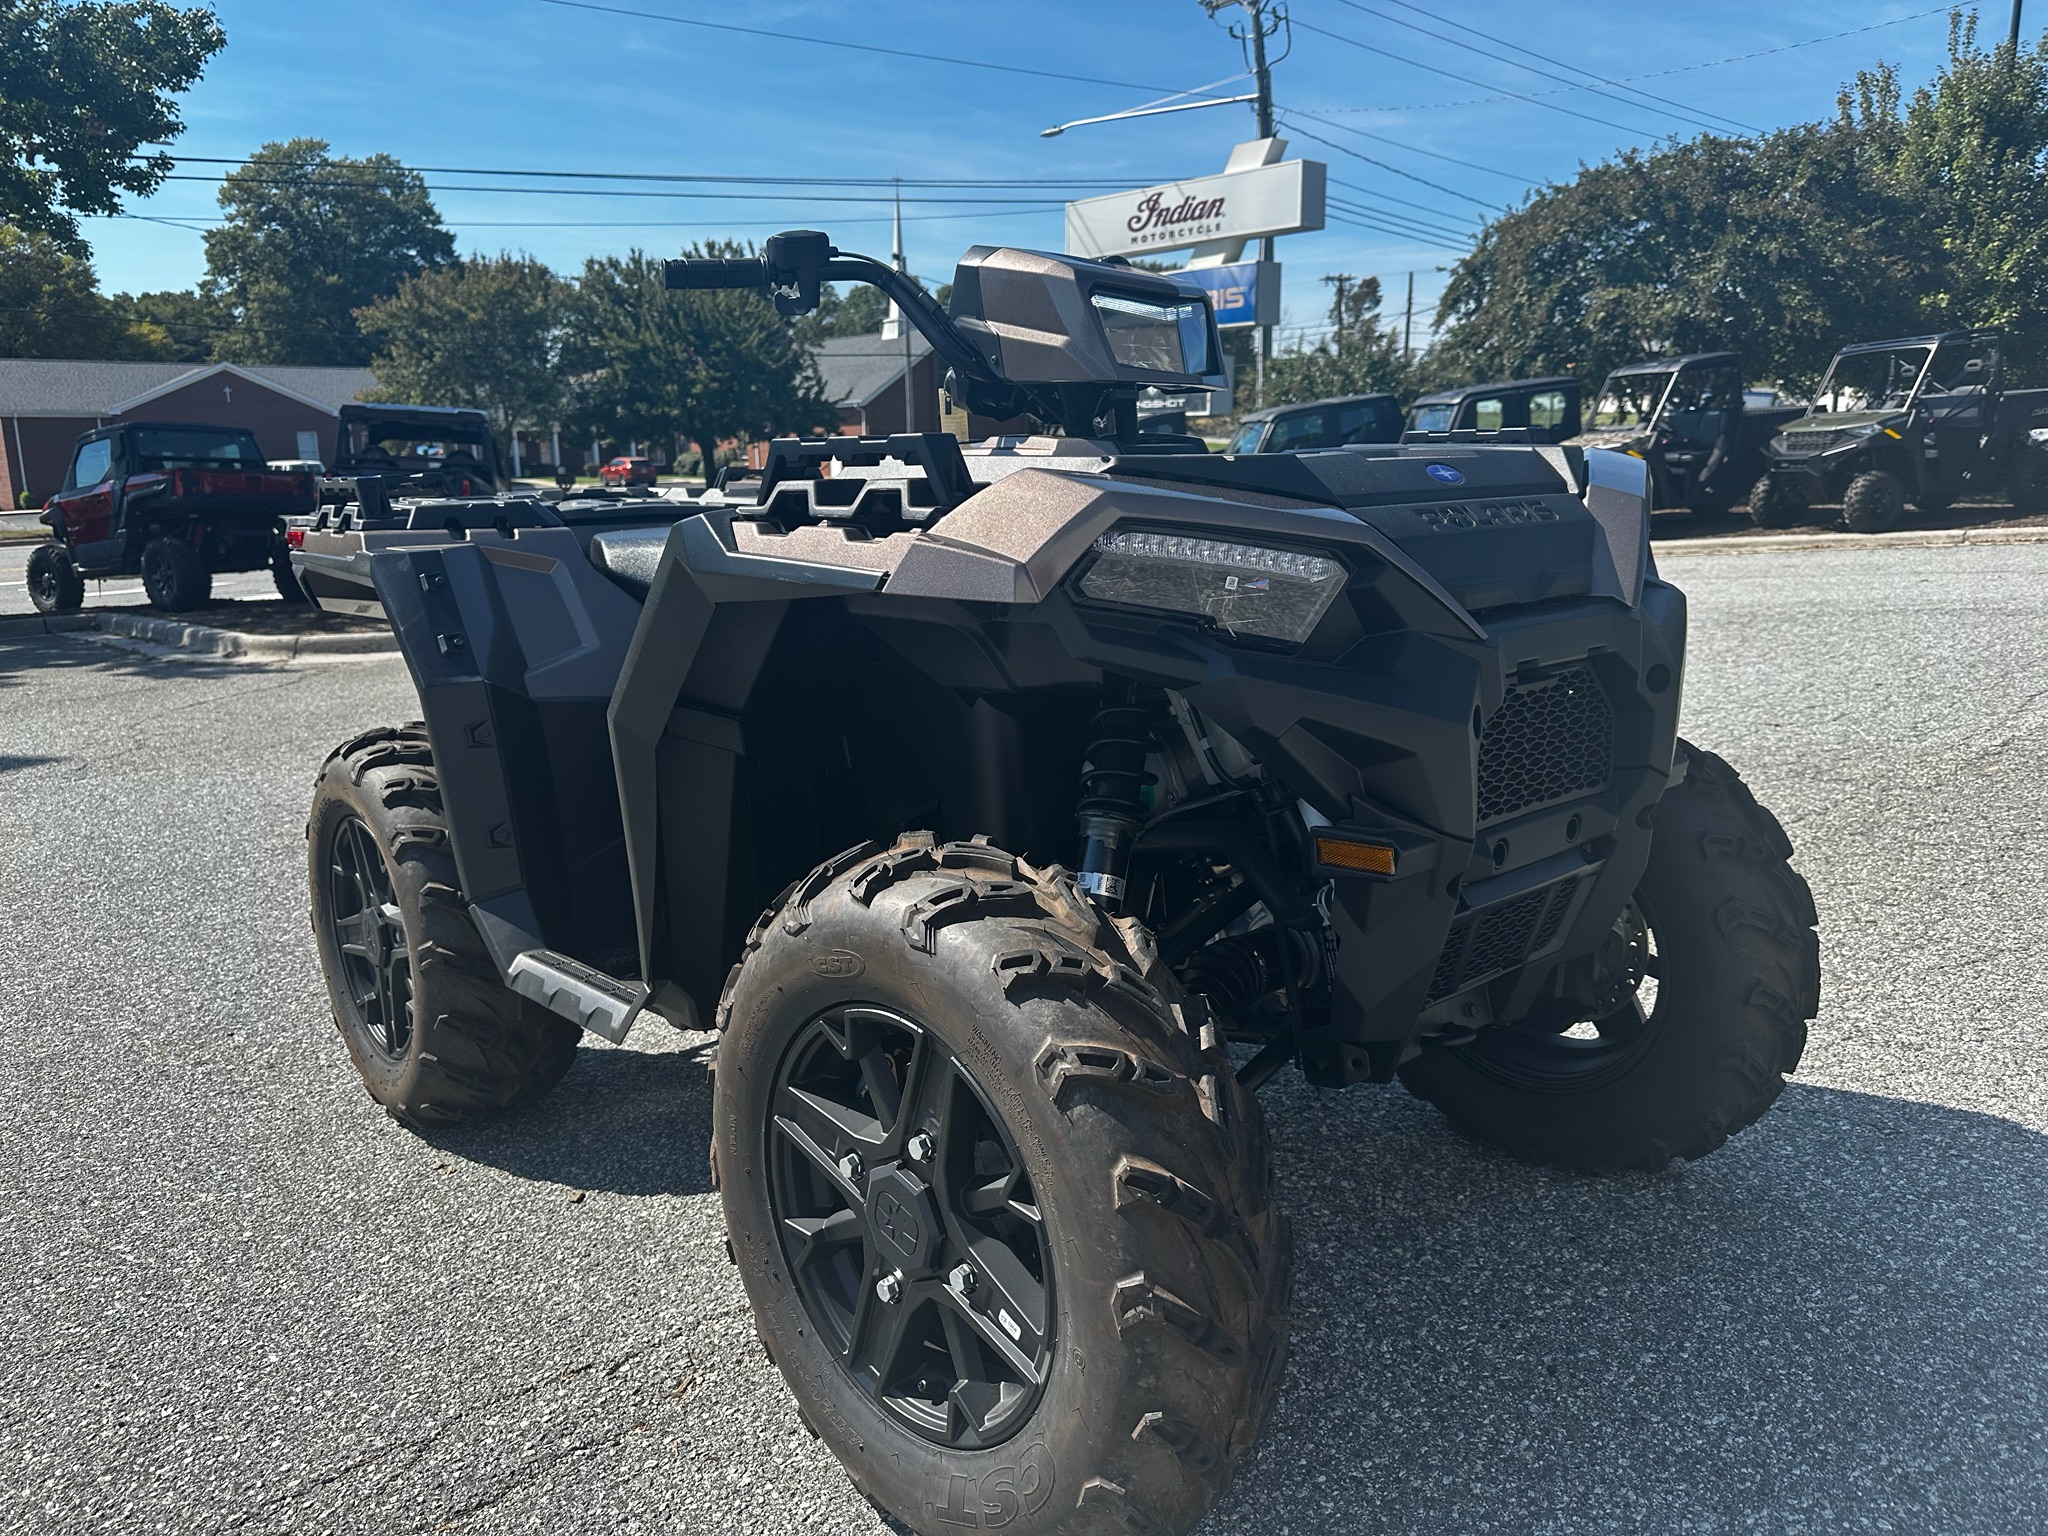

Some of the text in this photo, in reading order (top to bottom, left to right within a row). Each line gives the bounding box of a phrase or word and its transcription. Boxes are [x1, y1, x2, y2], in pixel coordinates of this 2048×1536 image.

[1127, 192, 1225, 233] Indian
[1130, 222, 1222, 246] MOTORCYCLE
[1412, 500, 1560, 532] POLARIS
[814, 956, 853, 974] CST
[936, 1441, 1056, 1529] CST
